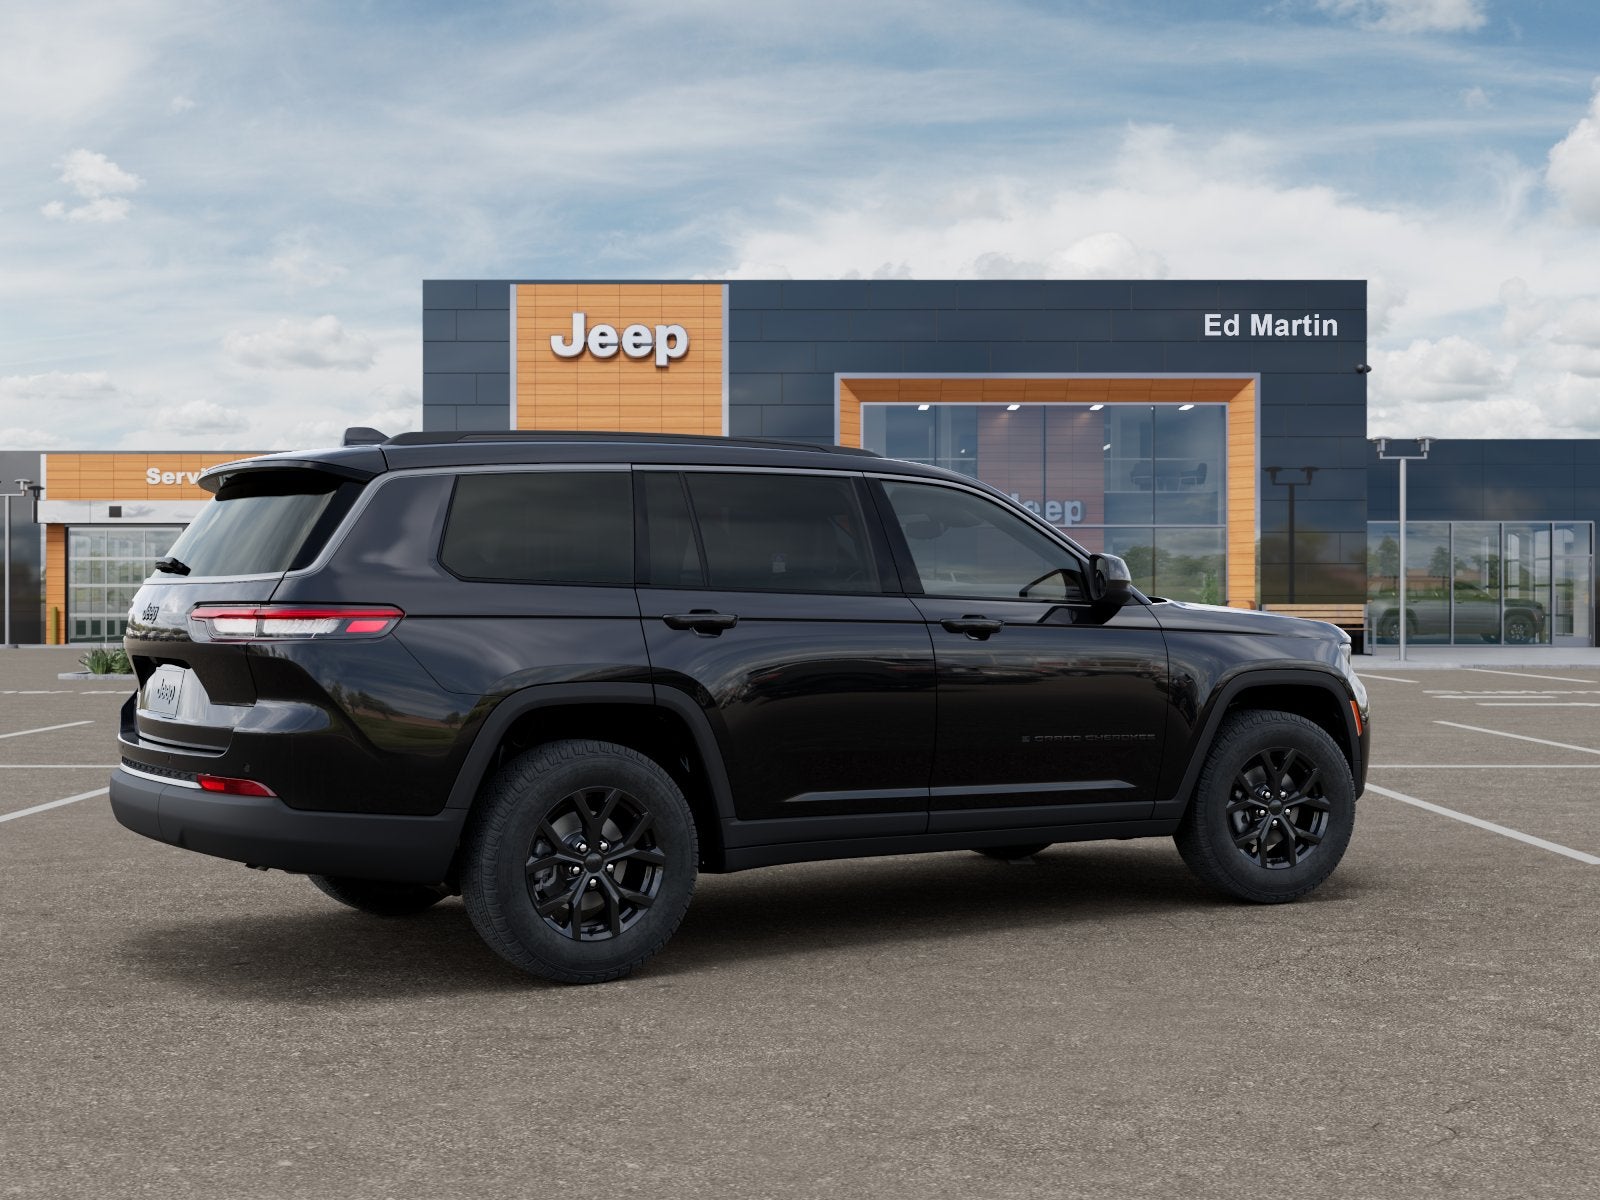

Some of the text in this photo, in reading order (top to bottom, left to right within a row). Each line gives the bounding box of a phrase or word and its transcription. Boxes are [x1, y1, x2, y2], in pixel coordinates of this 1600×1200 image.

[1204, 313, 1338, 336] Ed Martin
[550, 312, 688, 367] Jeep
[1009, 493, 1083, 527] eep
[142, 602, 159, 624] Jeep
[157, 678, 176, 704] Jeep
